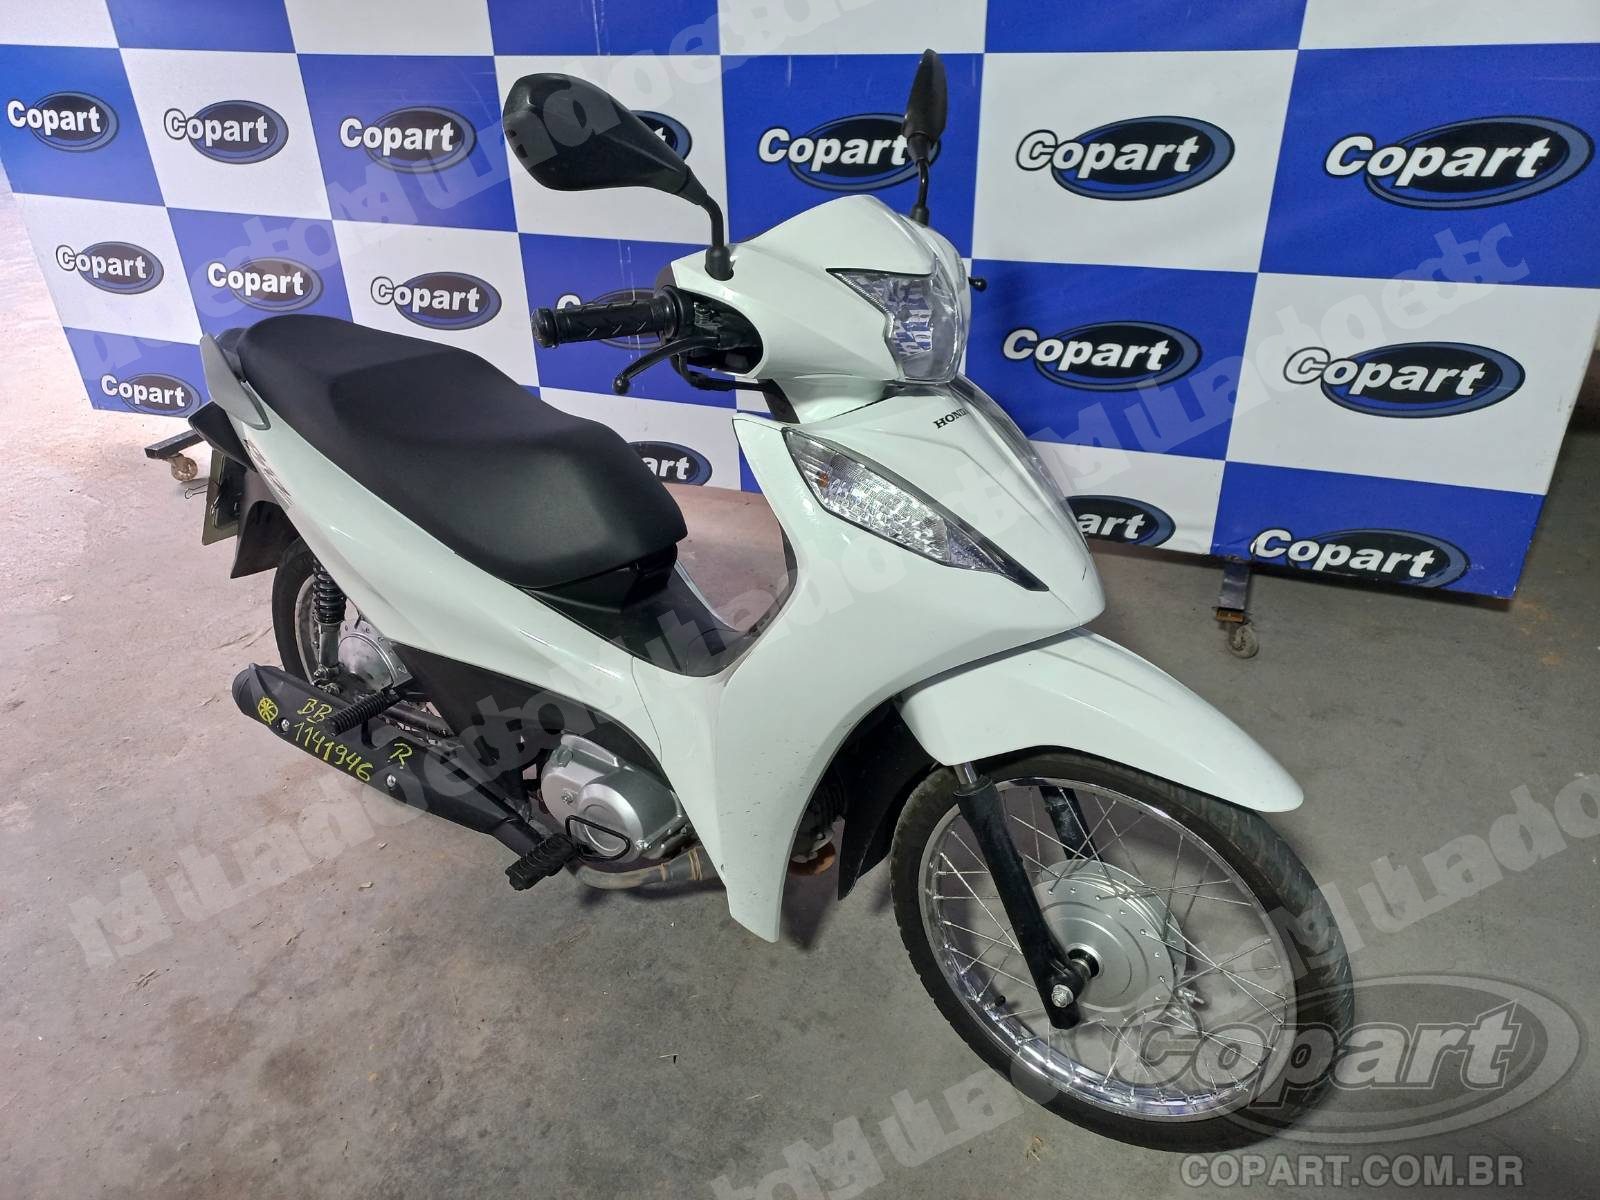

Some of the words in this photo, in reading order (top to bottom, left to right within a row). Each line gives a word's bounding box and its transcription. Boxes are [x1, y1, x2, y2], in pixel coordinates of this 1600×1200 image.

[8, 100, 100, 135] Copart
[164, 108, 267, 147] Copart
[340, 118, 454, 156] Copart
[758, 128, 908, 171] Copart
[1017, 130, 1202, 180] Copart
[1325, 134, 1553, 187] Copart
[56, 245, 146, 279] Copart
[208, 262, 304, 296] Copart
[371, 277, 480, 313] Copart
[1003, 329, 1169, 371] Copart
[1284, 347, 1487, 396] Copart
[101, 375, 185, 407] Copart
[933, 407, 969, 429] HOND
[641, 457, 690, 480] art
[1078, 513, 1145, 539] art
[1250, 529, 1435, 578] Copart
